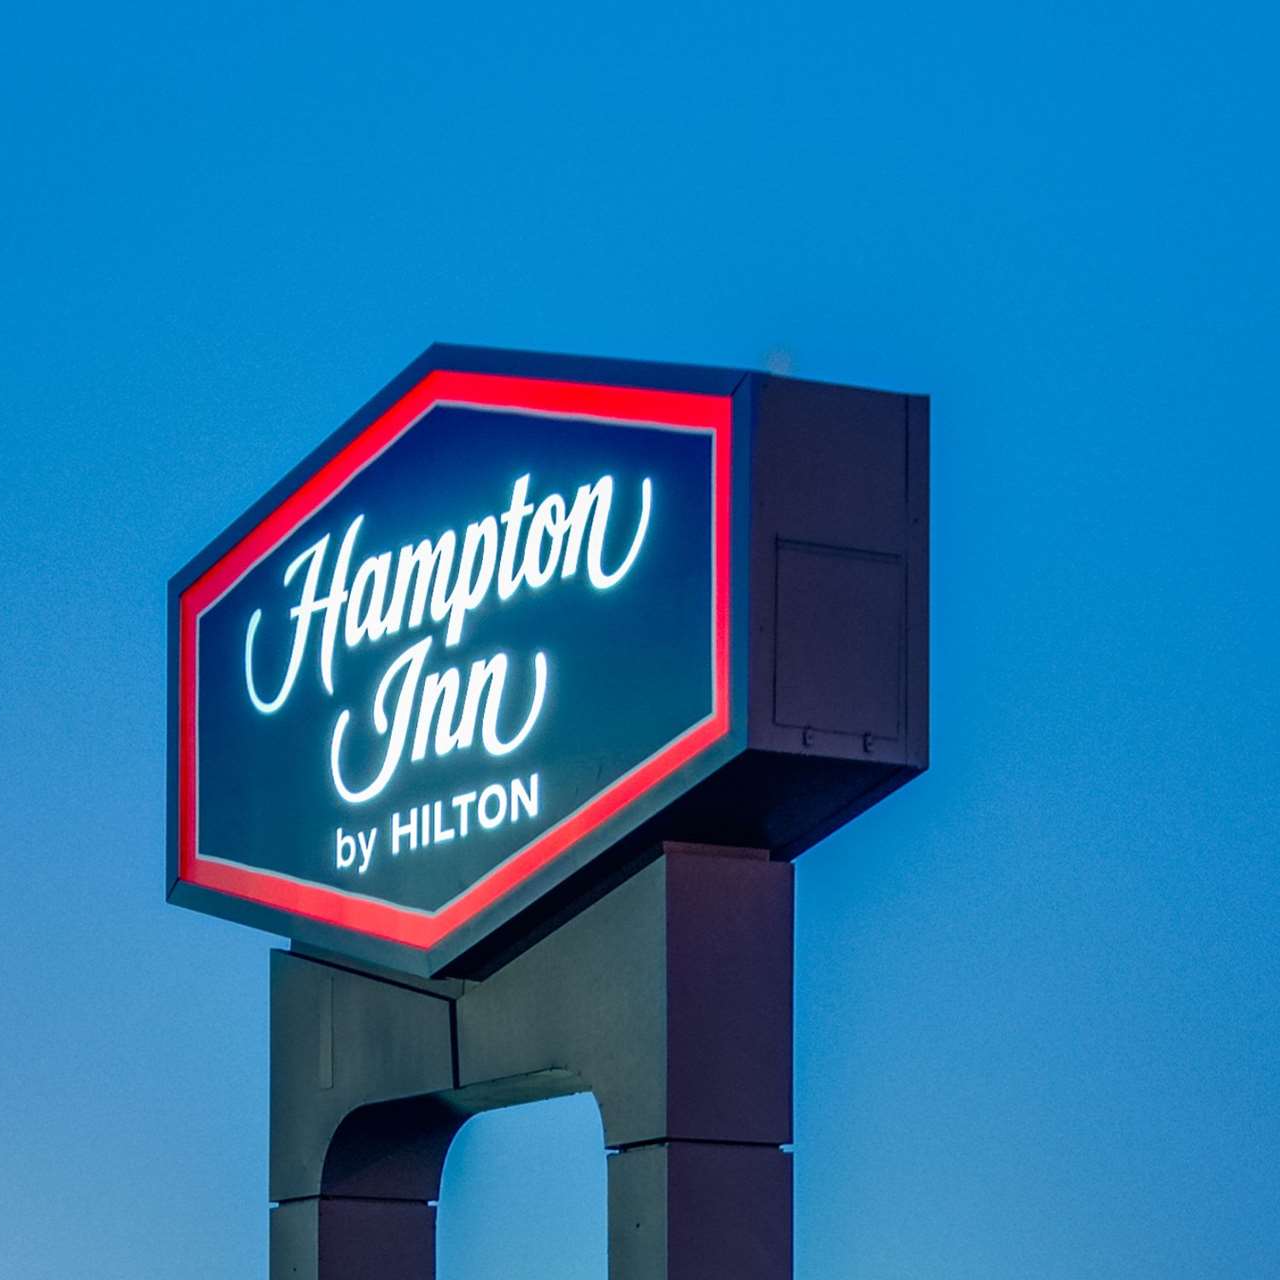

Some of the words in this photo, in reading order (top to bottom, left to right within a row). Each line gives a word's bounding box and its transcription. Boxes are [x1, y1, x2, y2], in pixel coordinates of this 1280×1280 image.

[245, 473, 652, 714] Hampton
[330, 635, 548, 804] Inn
[335, 825, 378, 874] by
[391, 772, 540, 855] HILTON
